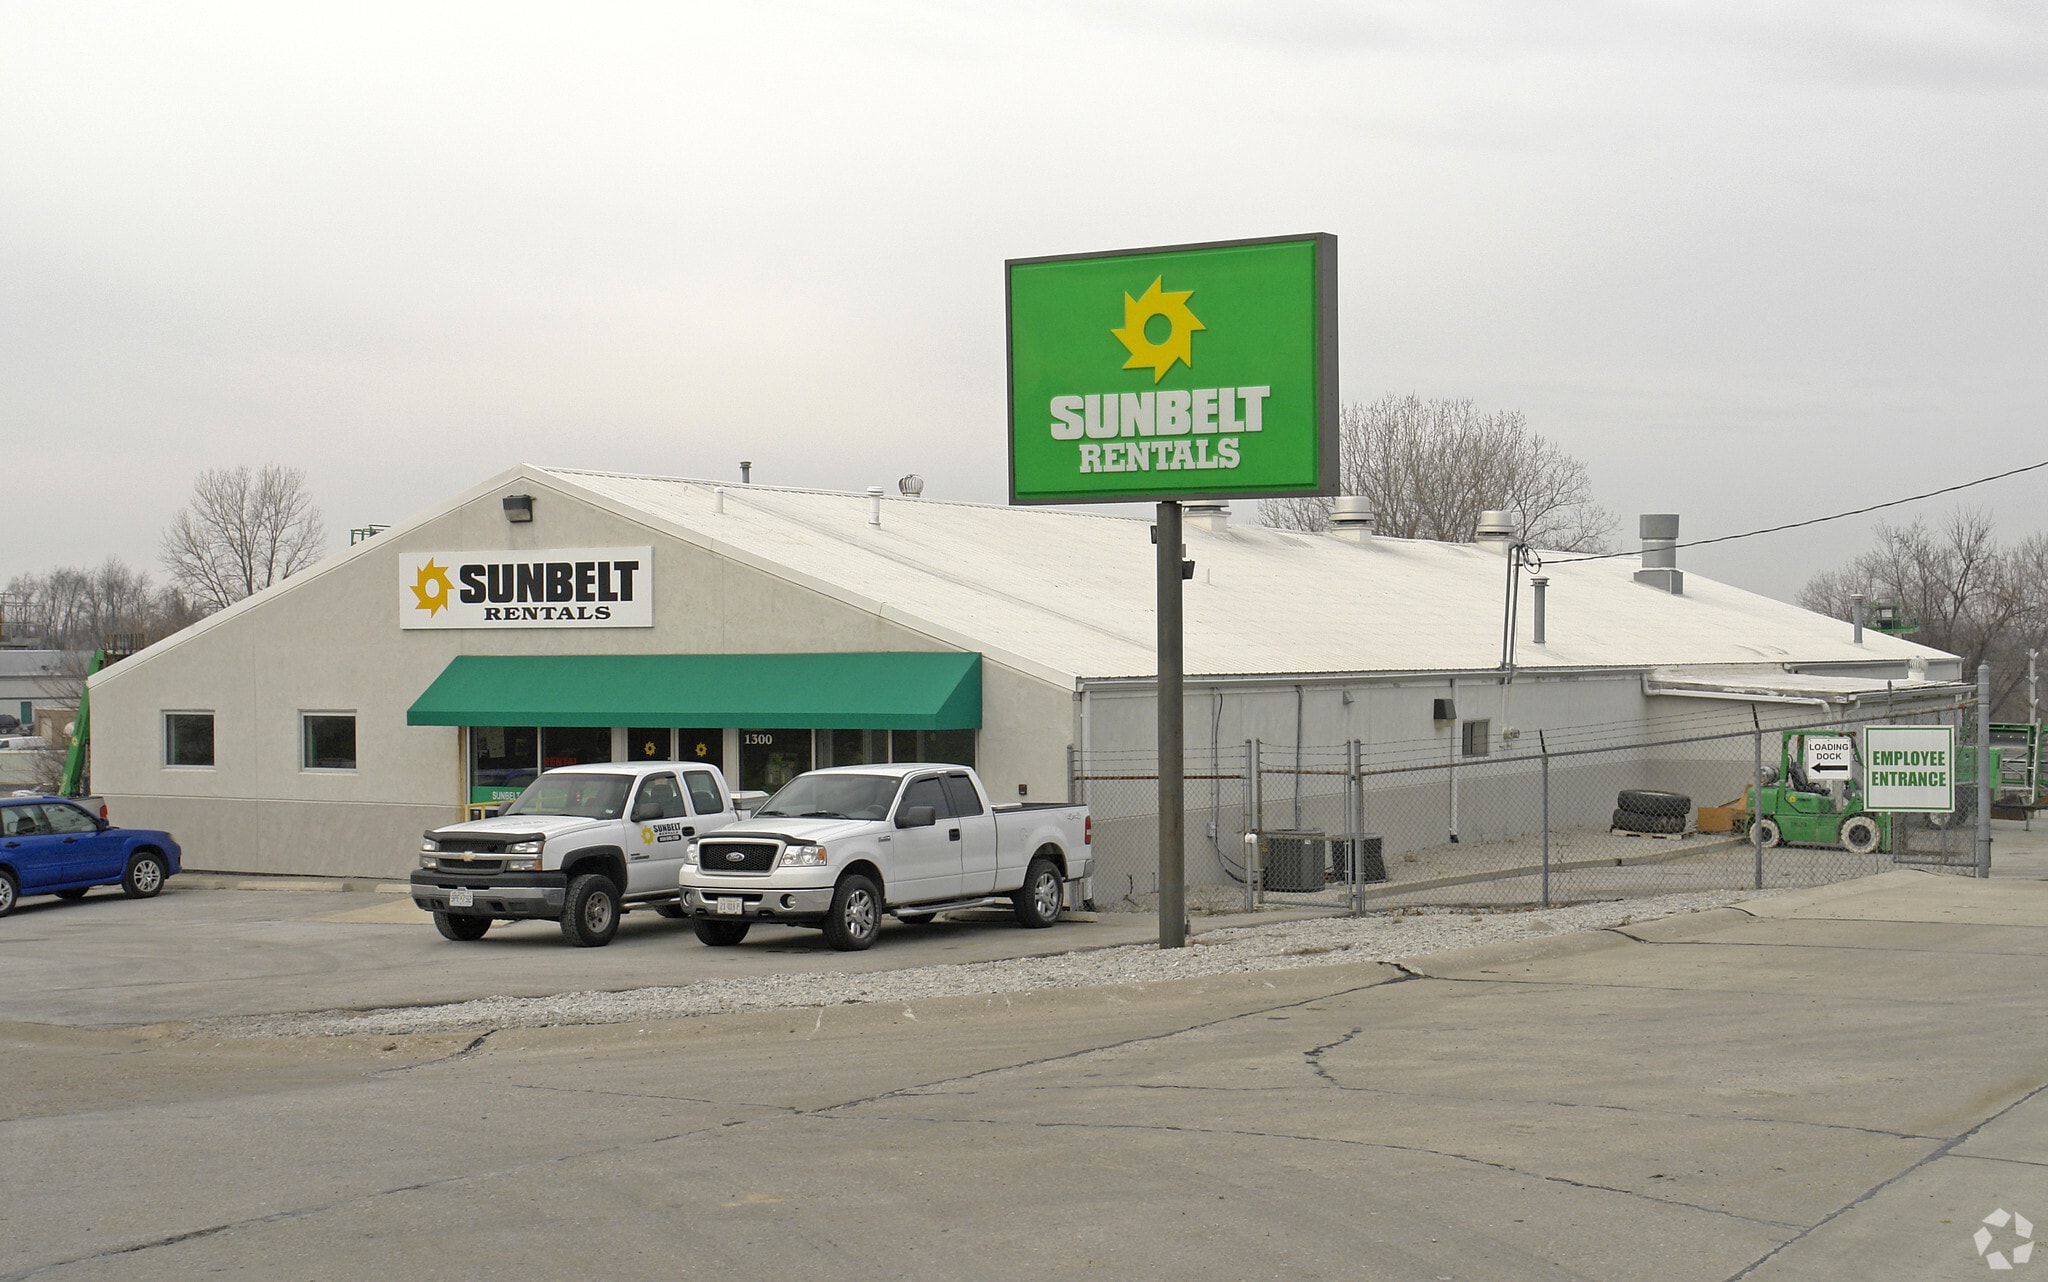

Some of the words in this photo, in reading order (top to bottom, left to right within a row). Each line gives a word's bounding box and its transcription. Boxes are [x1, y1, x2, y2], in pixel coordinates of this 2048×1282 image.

[1050, 386, 1270, 440] SUNBELT
[1079, 438, 1240, 473] RENTALS
[459, 560, 639, 603] SUNBELT
[484, 606, 611, 620] RENTALS
[745, 734, 773, 745] 1300
[1809, 743, 1849, 751] LOADING
[1816, 752, 1842, 760] DOCK
[1873, 751, 1945, 766] EMPLOYEE
[1872, 771, 1946, 787] ENTRANCE
[653, 822, 681, 833] SUNBELT
